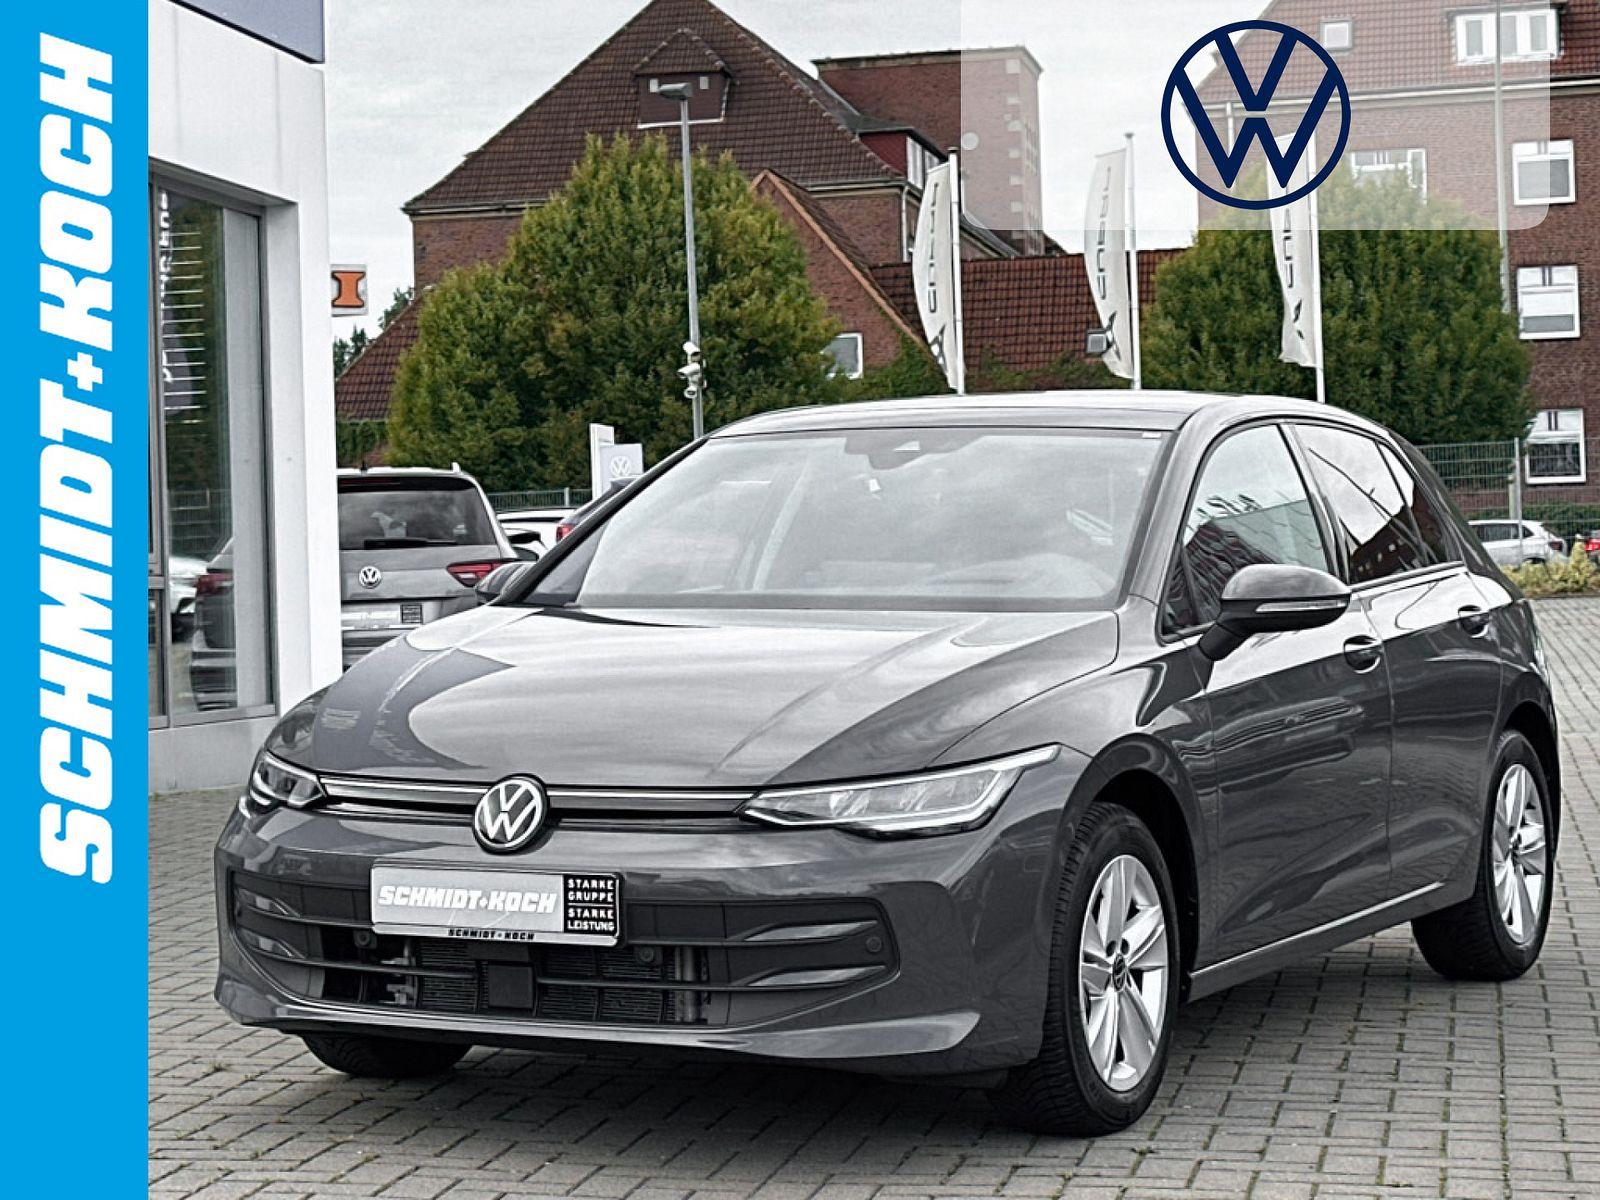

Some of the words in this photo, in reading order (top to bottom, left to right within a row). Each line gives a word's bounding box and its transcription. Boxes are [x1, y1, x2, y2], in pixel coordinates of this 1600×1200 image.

[474, 778, 544, 848] VW
[568, 879, 614, 890] STARKE
[568, 891, 614, 902] GRUPPE
[568, 908, 614, 919] STARKE
[567, 920, 615, 932] LEISTUNG
